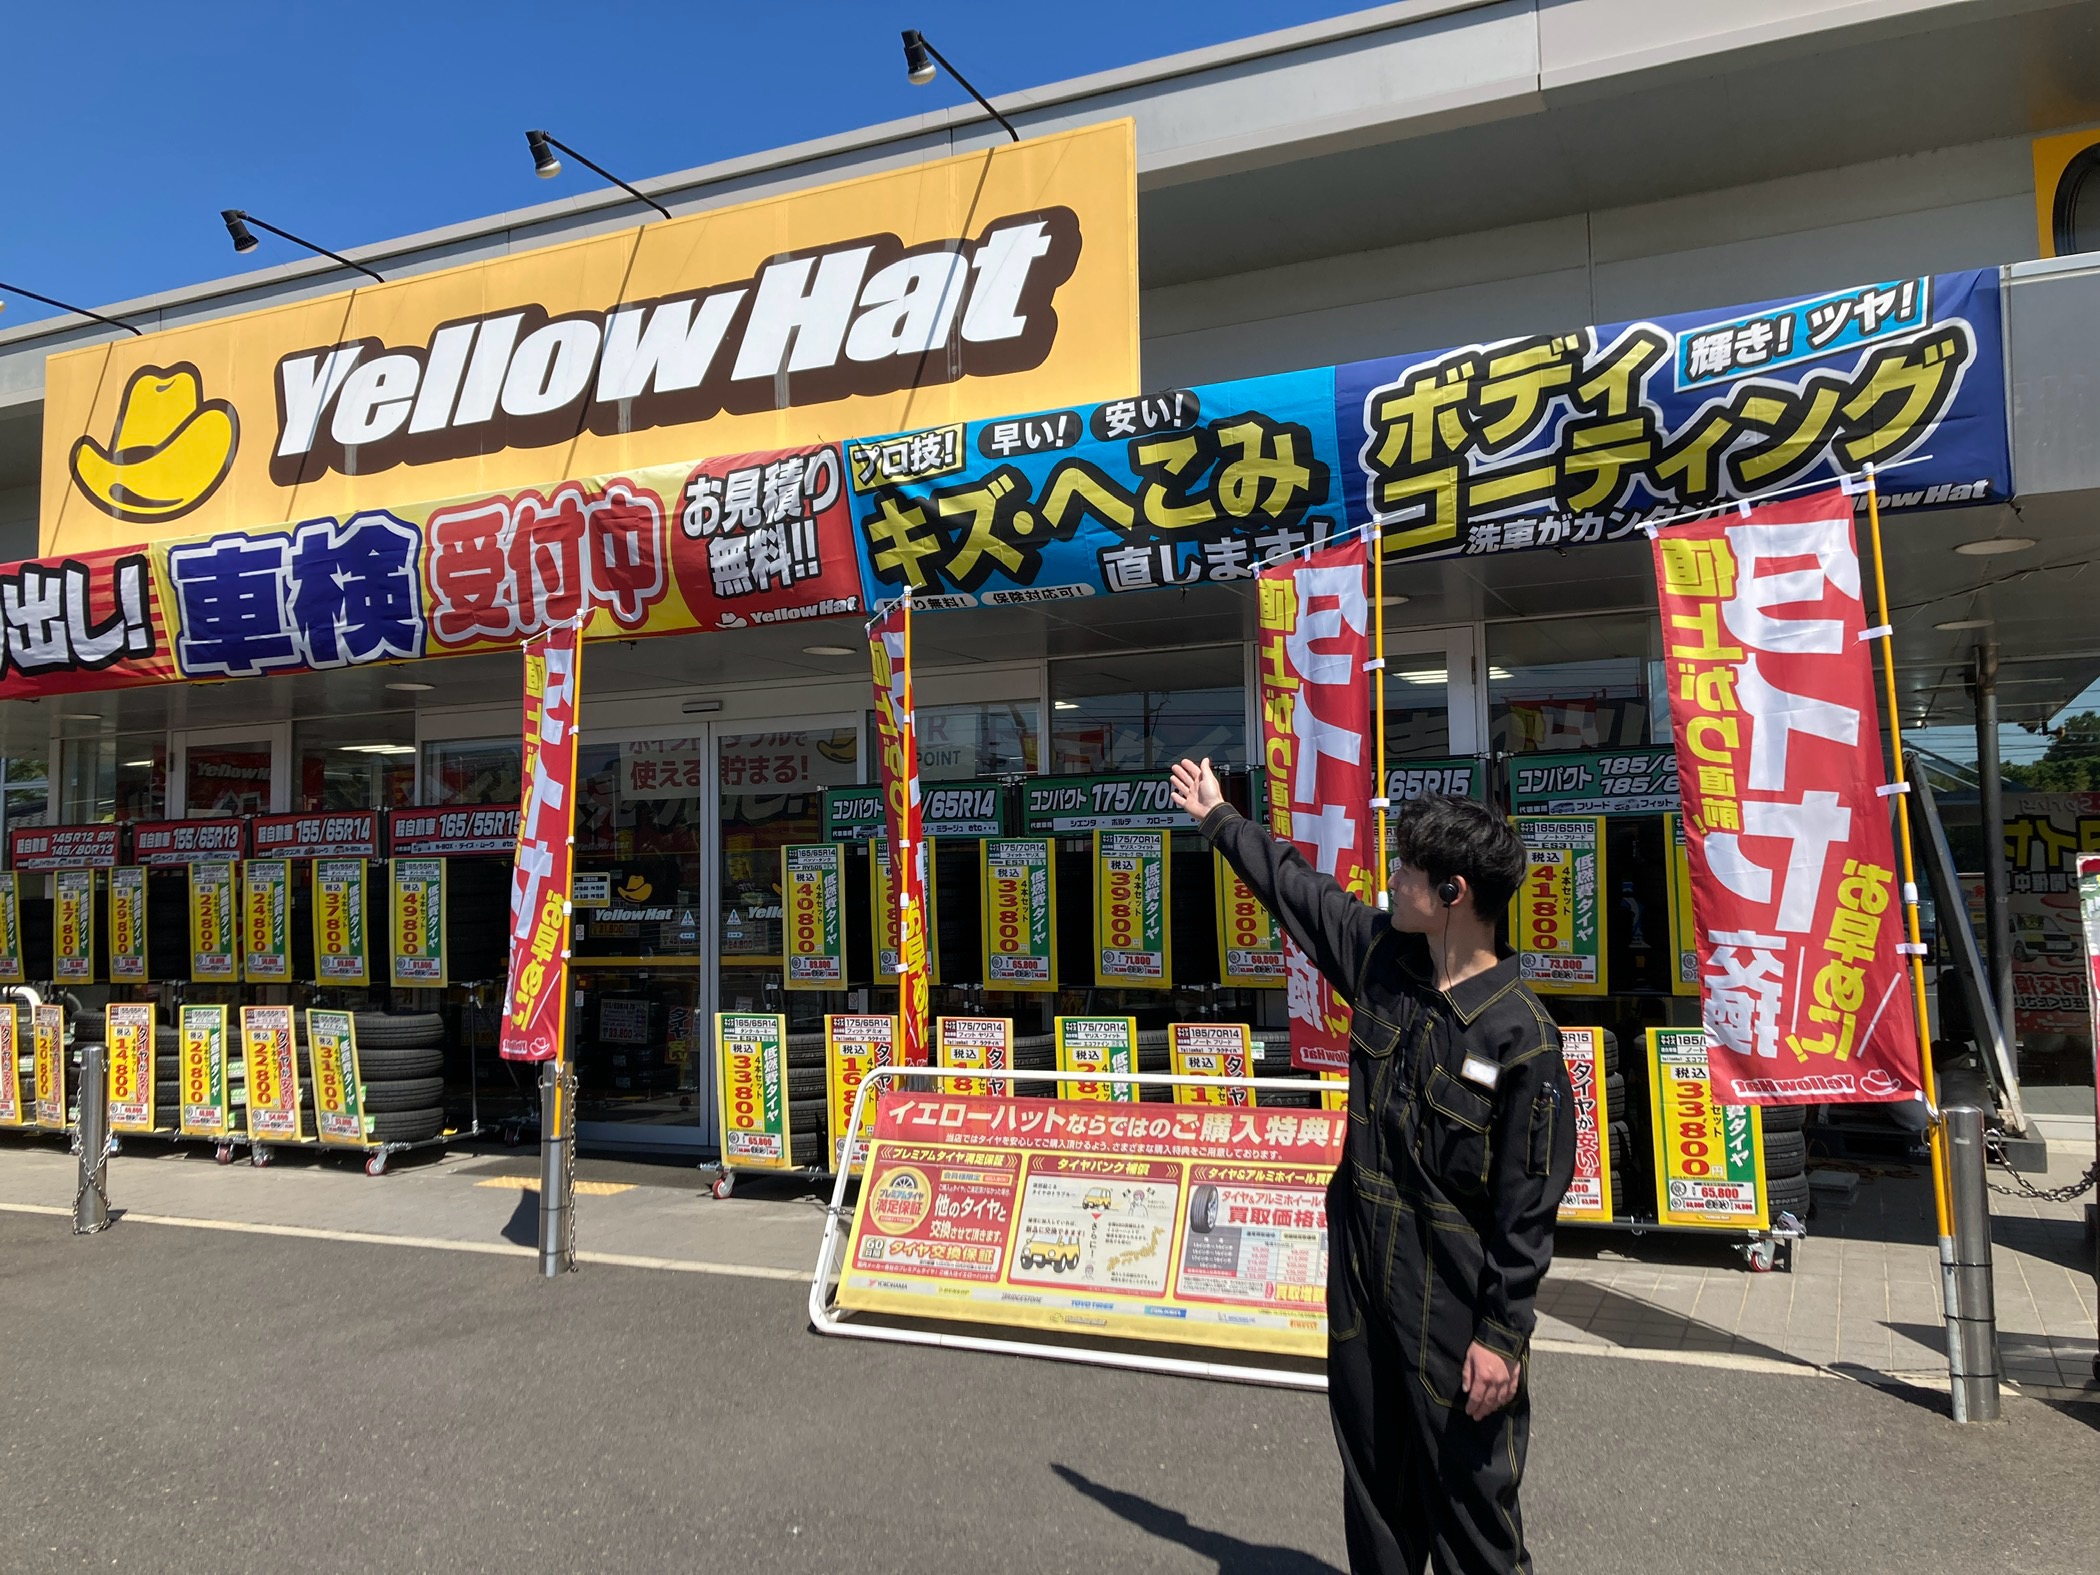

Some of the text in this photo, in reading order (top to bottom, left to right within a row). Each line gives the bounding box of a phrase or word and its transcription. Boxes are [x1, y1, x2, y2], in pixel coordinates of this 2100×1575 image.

[1690, 280, 1916, 377] 輝き! ツヤ!
[1105, 393, 1185, 438] 安い!
[1379, 333, 1656, 467] ボディ
[991, 415, 1067, 456] 早い!
[1383, 339, 1956, 554] コーティング
[855, 432, 956, 482] プロ技!
[684, 447, 839, 537] お見積り
[868, 421, 1311, 588] キズ・へこみ
[1853, 479, 1989, 512] lowHat
[1466, 502, 1726, 555] 洗車がカンタン
[1102, 521, 1332, 592] 直します!
[174, 490, 661, 672] 車検 受付中
[993, 585, 1086, 604] 保険対応可!
[0, 561, 150, 668] 出し!
[1029, 781, 1180, 812] コンパクト 175/70
[1517, 768, 1593, 794] コンパクト
[395, 811, 520, 839] 軽自動車 165/55R15
[831, 798, 884, 820] コンパクト
[921, 790, 997, 819] /65R14
[1577, 799, 1674, 811] フリード フィット
[172, 826, 240, 850] 155/65R13
[295, 817, 372, 843] 155/65R14
[1001, 843, 1045, 851] 175/70R14
[1114, 835, 1161, 843] 175/70R14
[1535, 823, 1595, 833] 185/65R15
[798, 849, 836, 857] 165/65R14
[997, 868, 1020, 878] 税込
[1110, 860, 1134, 870] 税込
[1531, 852, 1560, 863] 税込
[796, 873, 815, 882] 税込
[1134, 873, 1142, 917] 4本セット
[1561, 866, 1571, 916] 4本セット
[1574, 852, 1595, 942] 低燃費タイヤ
[797, 883, 815, 953] 40,800
[824, 872, 838, 945] 低燃費タイヤ
[998, 879, 1019, 952] 33,800
[1020, 880, 1029, 922] 4本セット
[1030, 868, 1046, 944] 低燃費タイヤ
[1110, 872, 1132, 947] 39,800
[1144, 861, 1160, 940] 低燃費タイヤ
[1233, 878, 1258, 947] 8,800
[1532, 865, 1558, 949] 41,800
[325, 893, 342, 954] 37,800
[403, 893, 418, 955] 49,800
[735, 1018, 777, 1027] 165/65R14
[846, 1018, 889, 1027] 175/65R14
[958, 1022, 1002, 1031] 175/70R14
[1077, 1022, 1127, 1032] 175/70R14
[1190, 1029, 1240, 1038] 185/70R14
[115, 1038, 128, 1098] 14,800
[732, 1043, 754, 1053] 税込
[842, 1044, 865, 1054] 税込
[953, 1048, 977, 1059] 税込
[1075, 1049, 1100, 1060] 税込
[1188, 1057, 1214, 1068] 税込
[190, 1041, 204, 1103] 20,800
[254, 1042, 271, 1104] 22,800
[320, 1047, 339, 1111] 31,800
[733, 1055, 754, 1128] 33,800
[754, 1056, 762, 1100] 4本セット
[763, 1045, 779, 1122] 低燃費タイヤ
[1675, 1067, 1707, 1078] 税込
[888, 1100, 1345, 1148] イエローハットならではのご購入特典!
[1676, 1081, 1710, 1176] 33,800
[875, 1199, 923, 1216] 満足保証
[934, 1193, 1007, 1222] 他のタイヤと
[1222, 1190, 1326, 1207] タイヤ&アルミホイール
[1701, 1187, 1739, 1199] 65,800
[866, 1238, 884, 1249] 60
[889, 1240, 996, 1264] タイヤ交換保証
